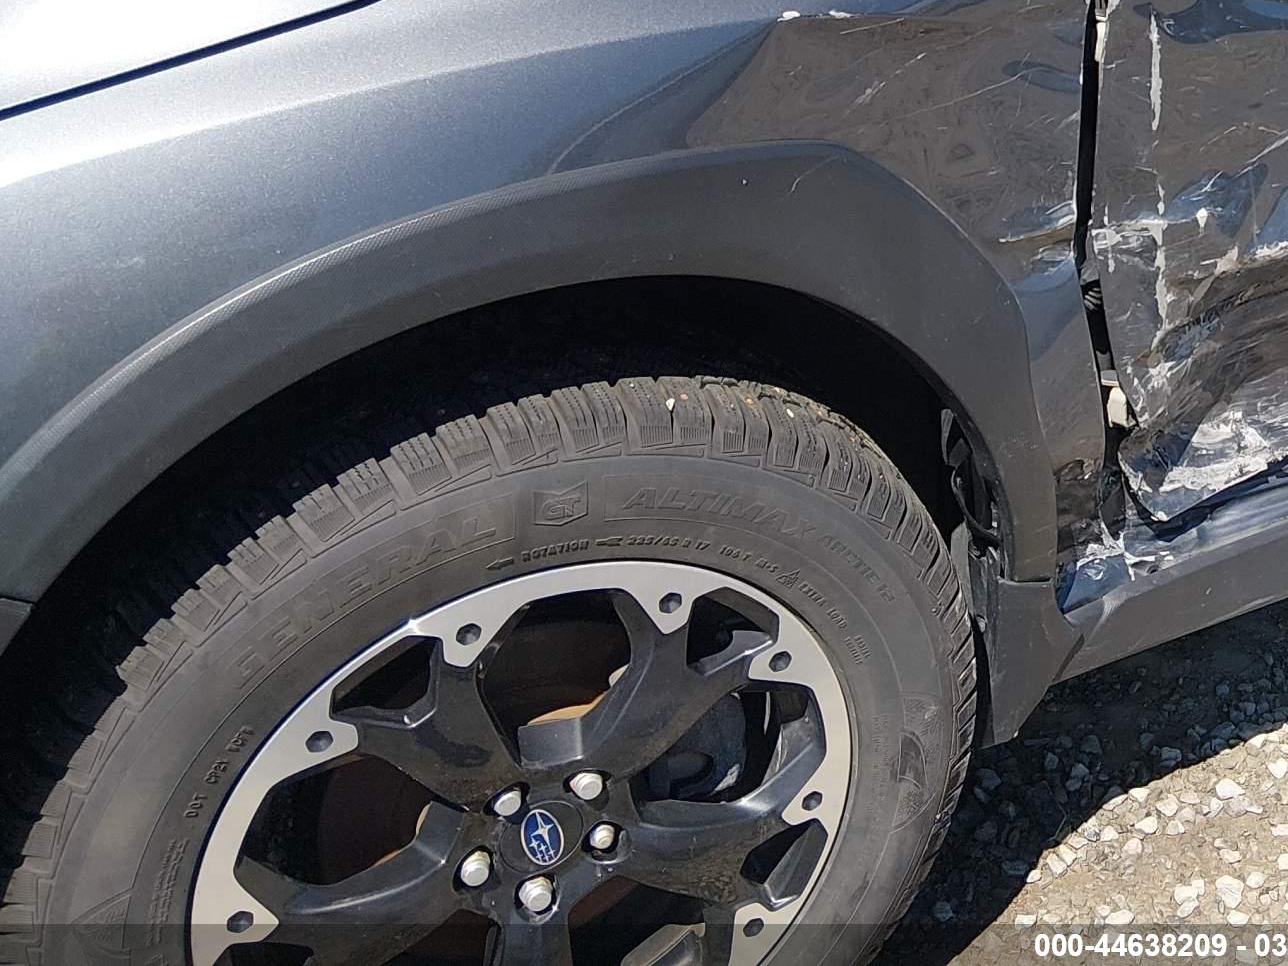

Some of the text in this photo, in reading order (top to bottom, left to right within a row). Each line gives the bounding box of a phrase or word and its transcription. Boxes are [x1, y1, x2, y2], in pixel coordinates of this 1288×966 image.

[622, 487, 817, 536] ALTIMAX
[520, 538, 590, 563] ROTATION
[230, 516, 498, 691] GENERAL
